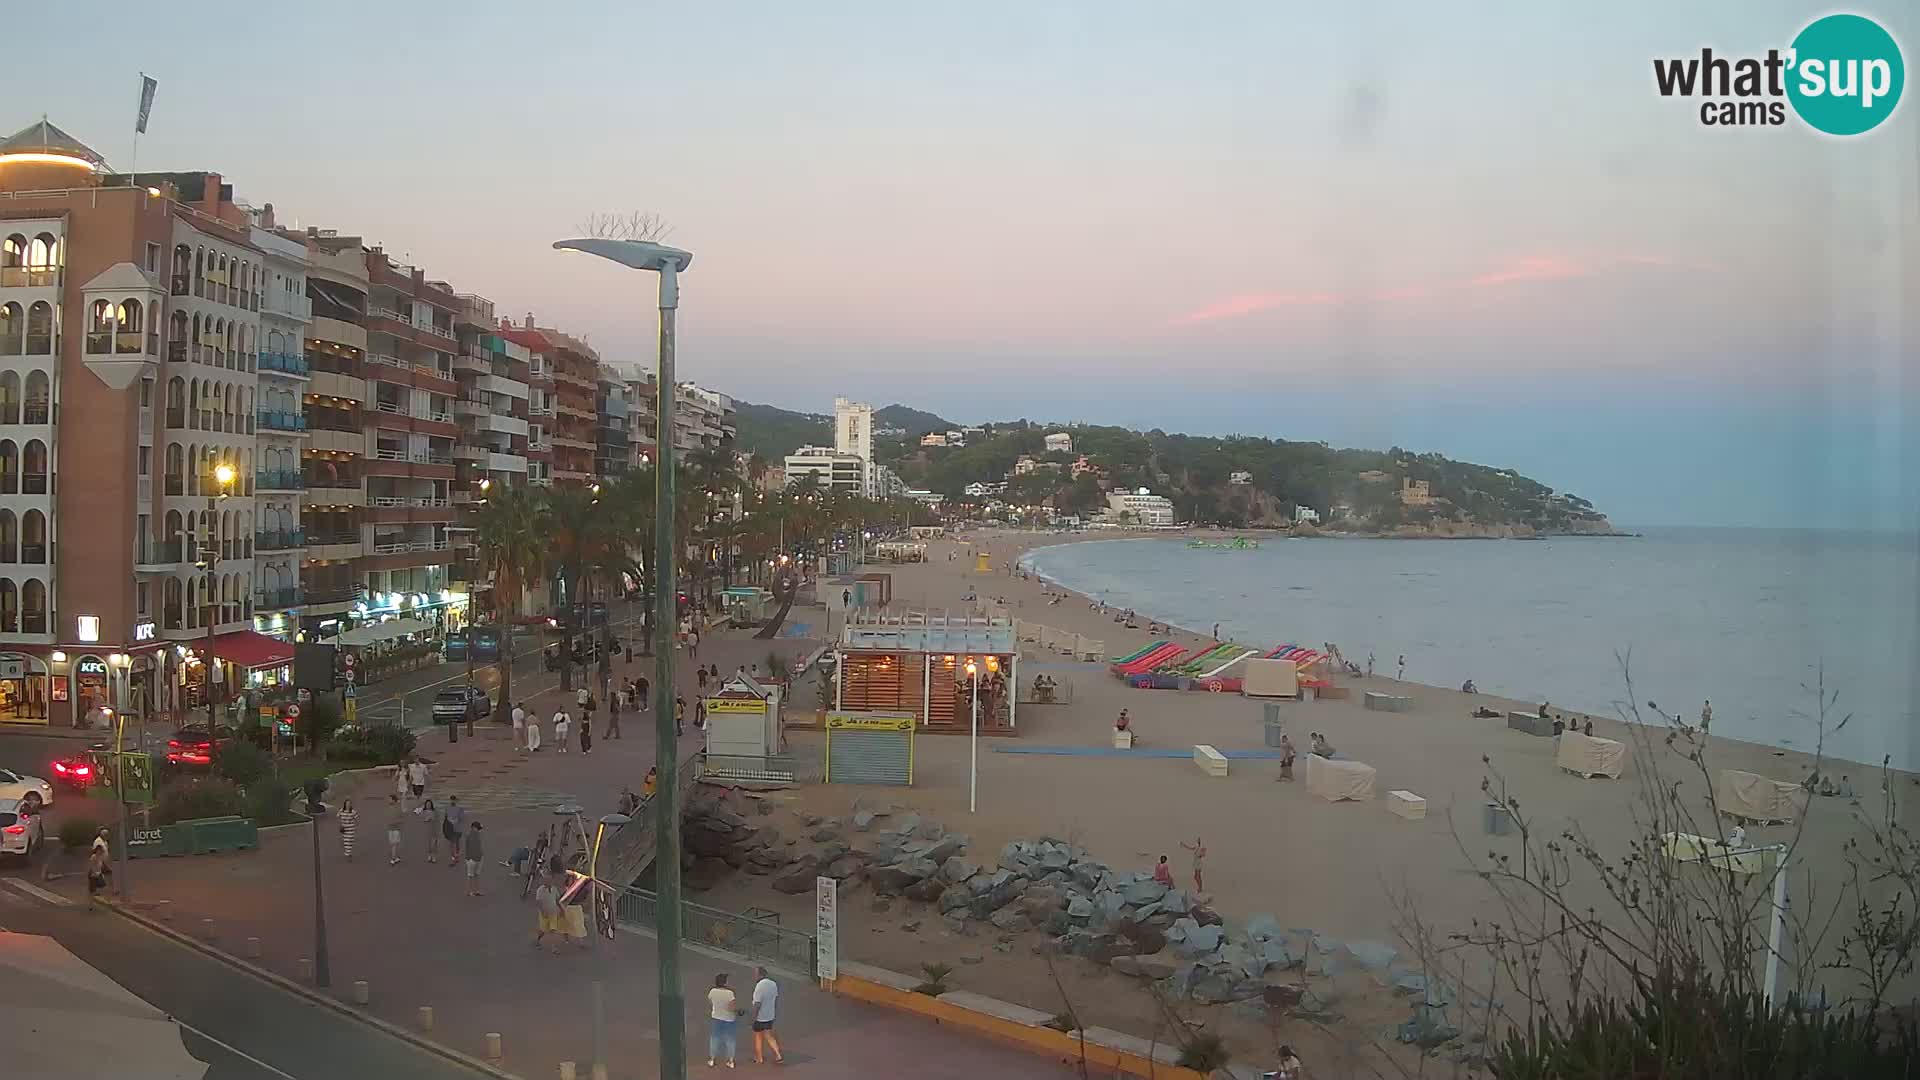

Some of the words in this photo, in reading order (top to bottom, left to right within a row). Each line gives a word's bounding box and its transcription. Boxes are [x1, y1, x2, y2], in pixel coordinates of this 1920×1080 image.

[136, 623, 155, 640] KFC
[81, 662, 105, 672] KFC
[133, 827, 163, 840] lloret
